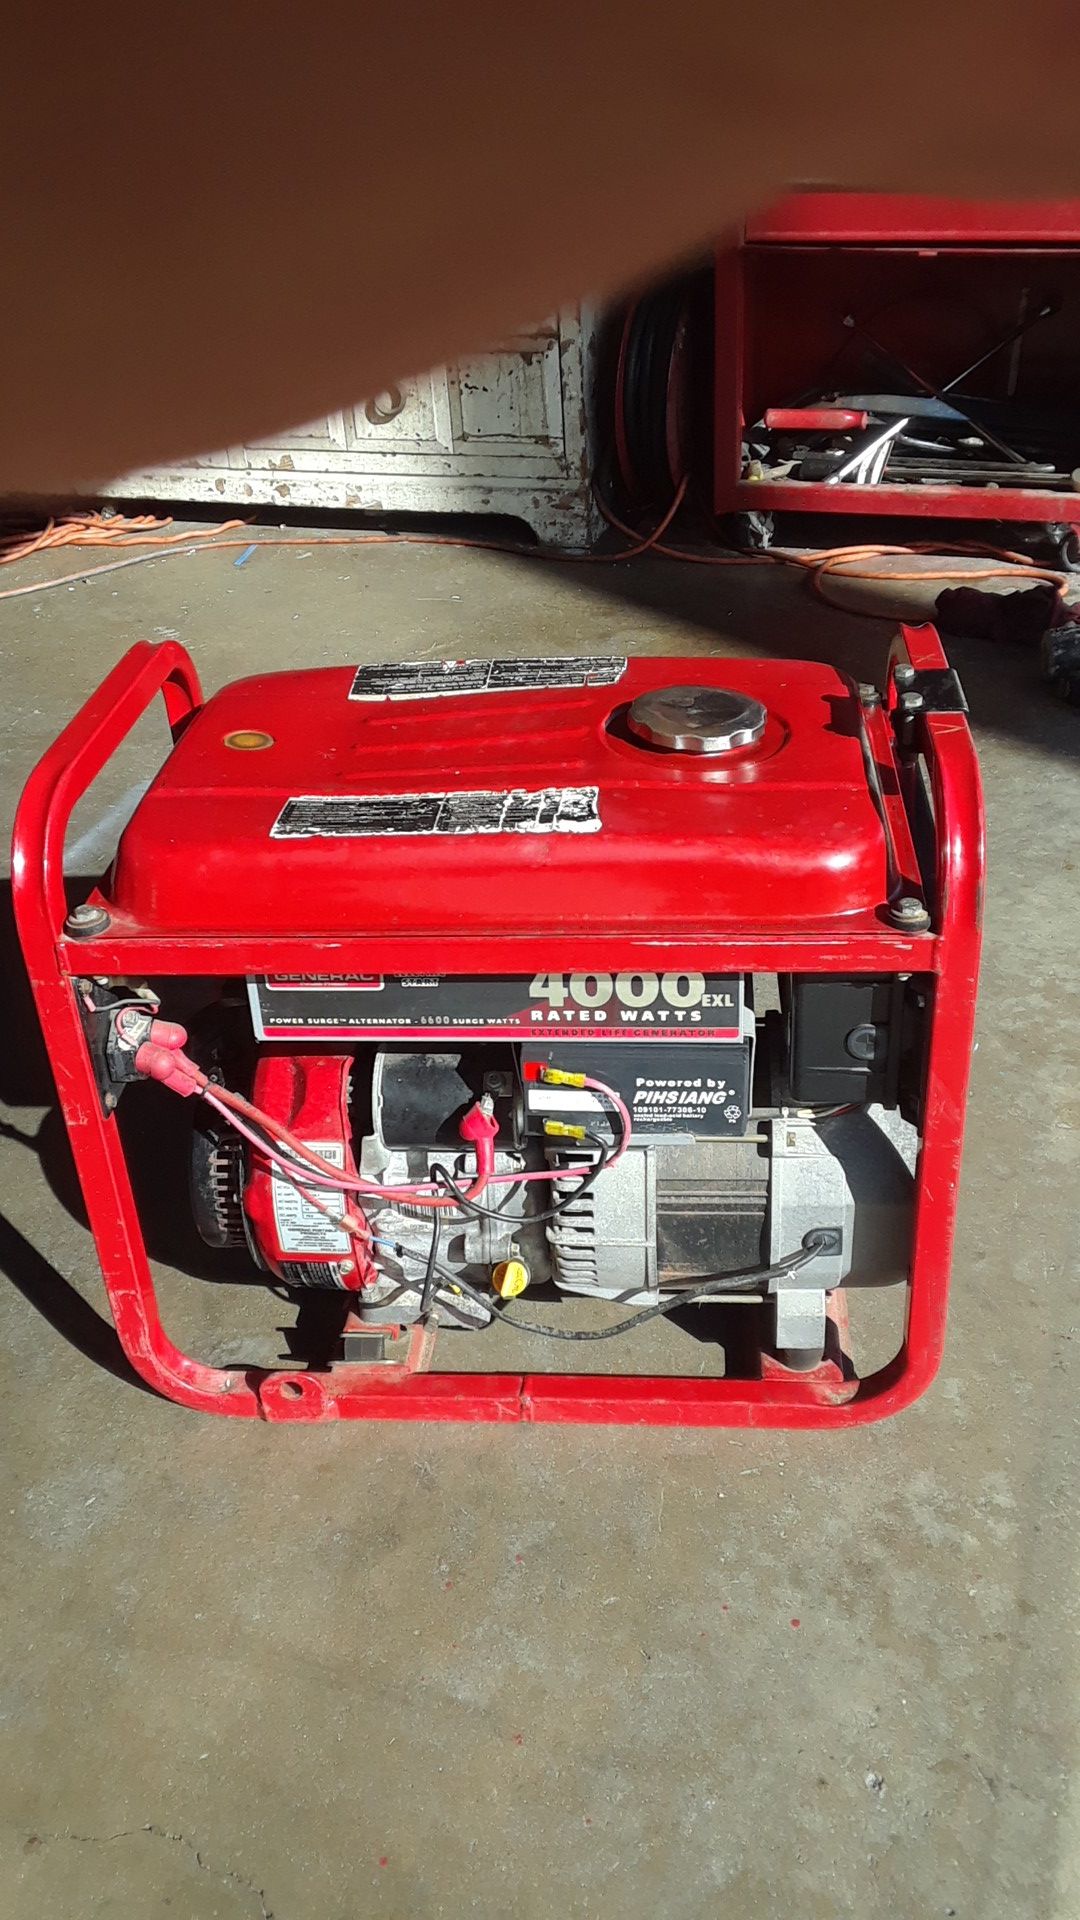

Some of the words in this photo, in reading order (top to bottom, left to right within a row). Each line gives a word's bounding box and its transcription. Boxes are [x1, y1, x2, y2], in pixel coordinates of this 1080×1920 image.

[529, 972, 706, 1008] 4000
[702, 993, 735, 1007] EXL
[269, 1017, 304, 1025] POWER
[348, 1017, 412, 1025] ALTERNATOR
[420, 1015, 450, 1025] 6600
[452, 1017, 484, 1025] SURGE
[486, 1017, 521, 1025] WATTS
[531, 1010, 607, 1022] RATED
[620, 1010, 702, 1022] WATTS
[531, 1028, 595, 1037] EXTENDED
[601, 1028, 627, 1037] LIFE
[633, 1028, 716, 1037] GENERATOR
[636, 1077, 702, 1088] Powered
[706, 1078, 726, 1089] by
